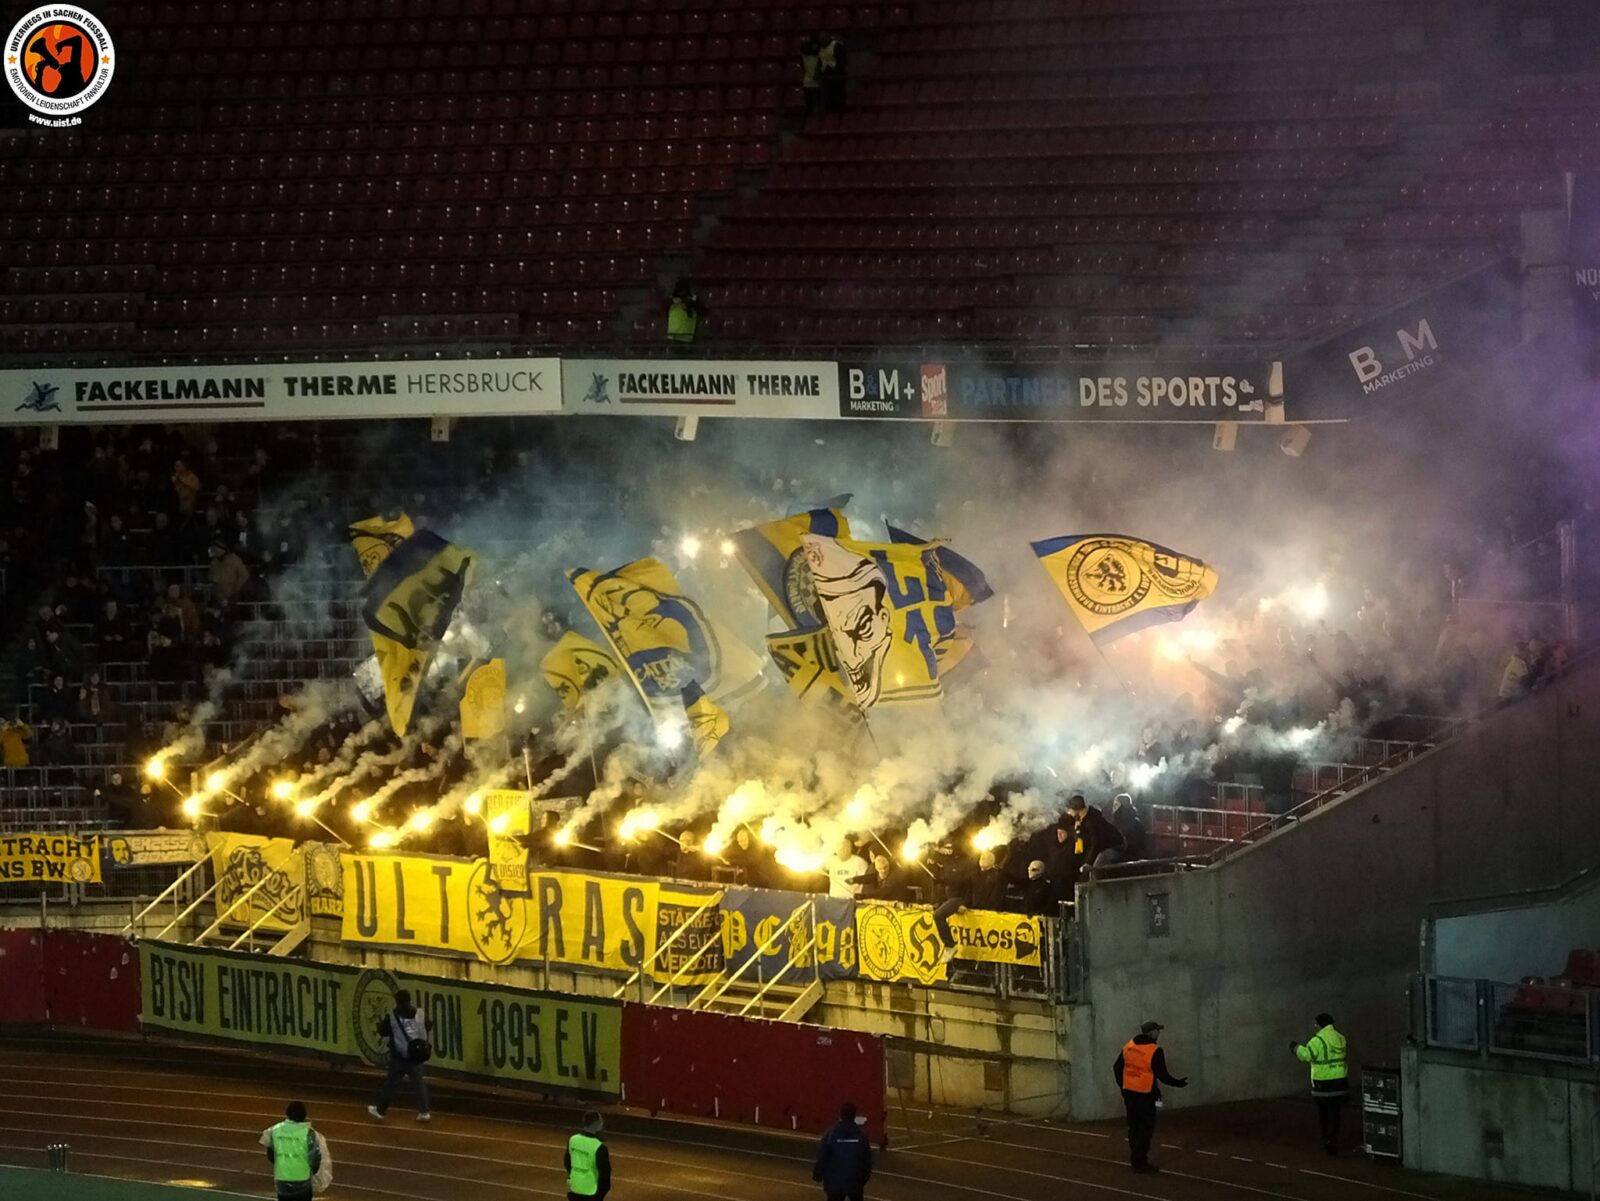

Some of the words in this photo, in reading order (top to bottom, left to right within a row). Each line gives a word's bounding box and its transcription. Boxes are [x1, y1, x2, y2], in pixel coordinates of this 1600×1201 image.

[75, 377, 265, 401] FACKELMANN
[284, 374, 397, 397] THERME
[408, 372, 543, 394] HERSBRUCK
[618, 373, 736, 395] FACKELMANN
[747, 374, 820, 396] THERME
[1362, 355, 1434, 394] MARKETING
[1079, 377, 1128, 407] DES
[1136, 375, 1238, 407] SPORTS
[850, 400, 894, 412] MARKETING
[0, 837, 96, 857] TRACHT
[31, 860, 66, 878] BW
[950, 925, 1013, 950] CHAOS
[151, 953, 204, 1025] BTSV
[217, 964, 342, 1044] EINTRACHT
[477, 997, 543, 1073] 1895
[555, 1008, 609, 1083] E.V.
